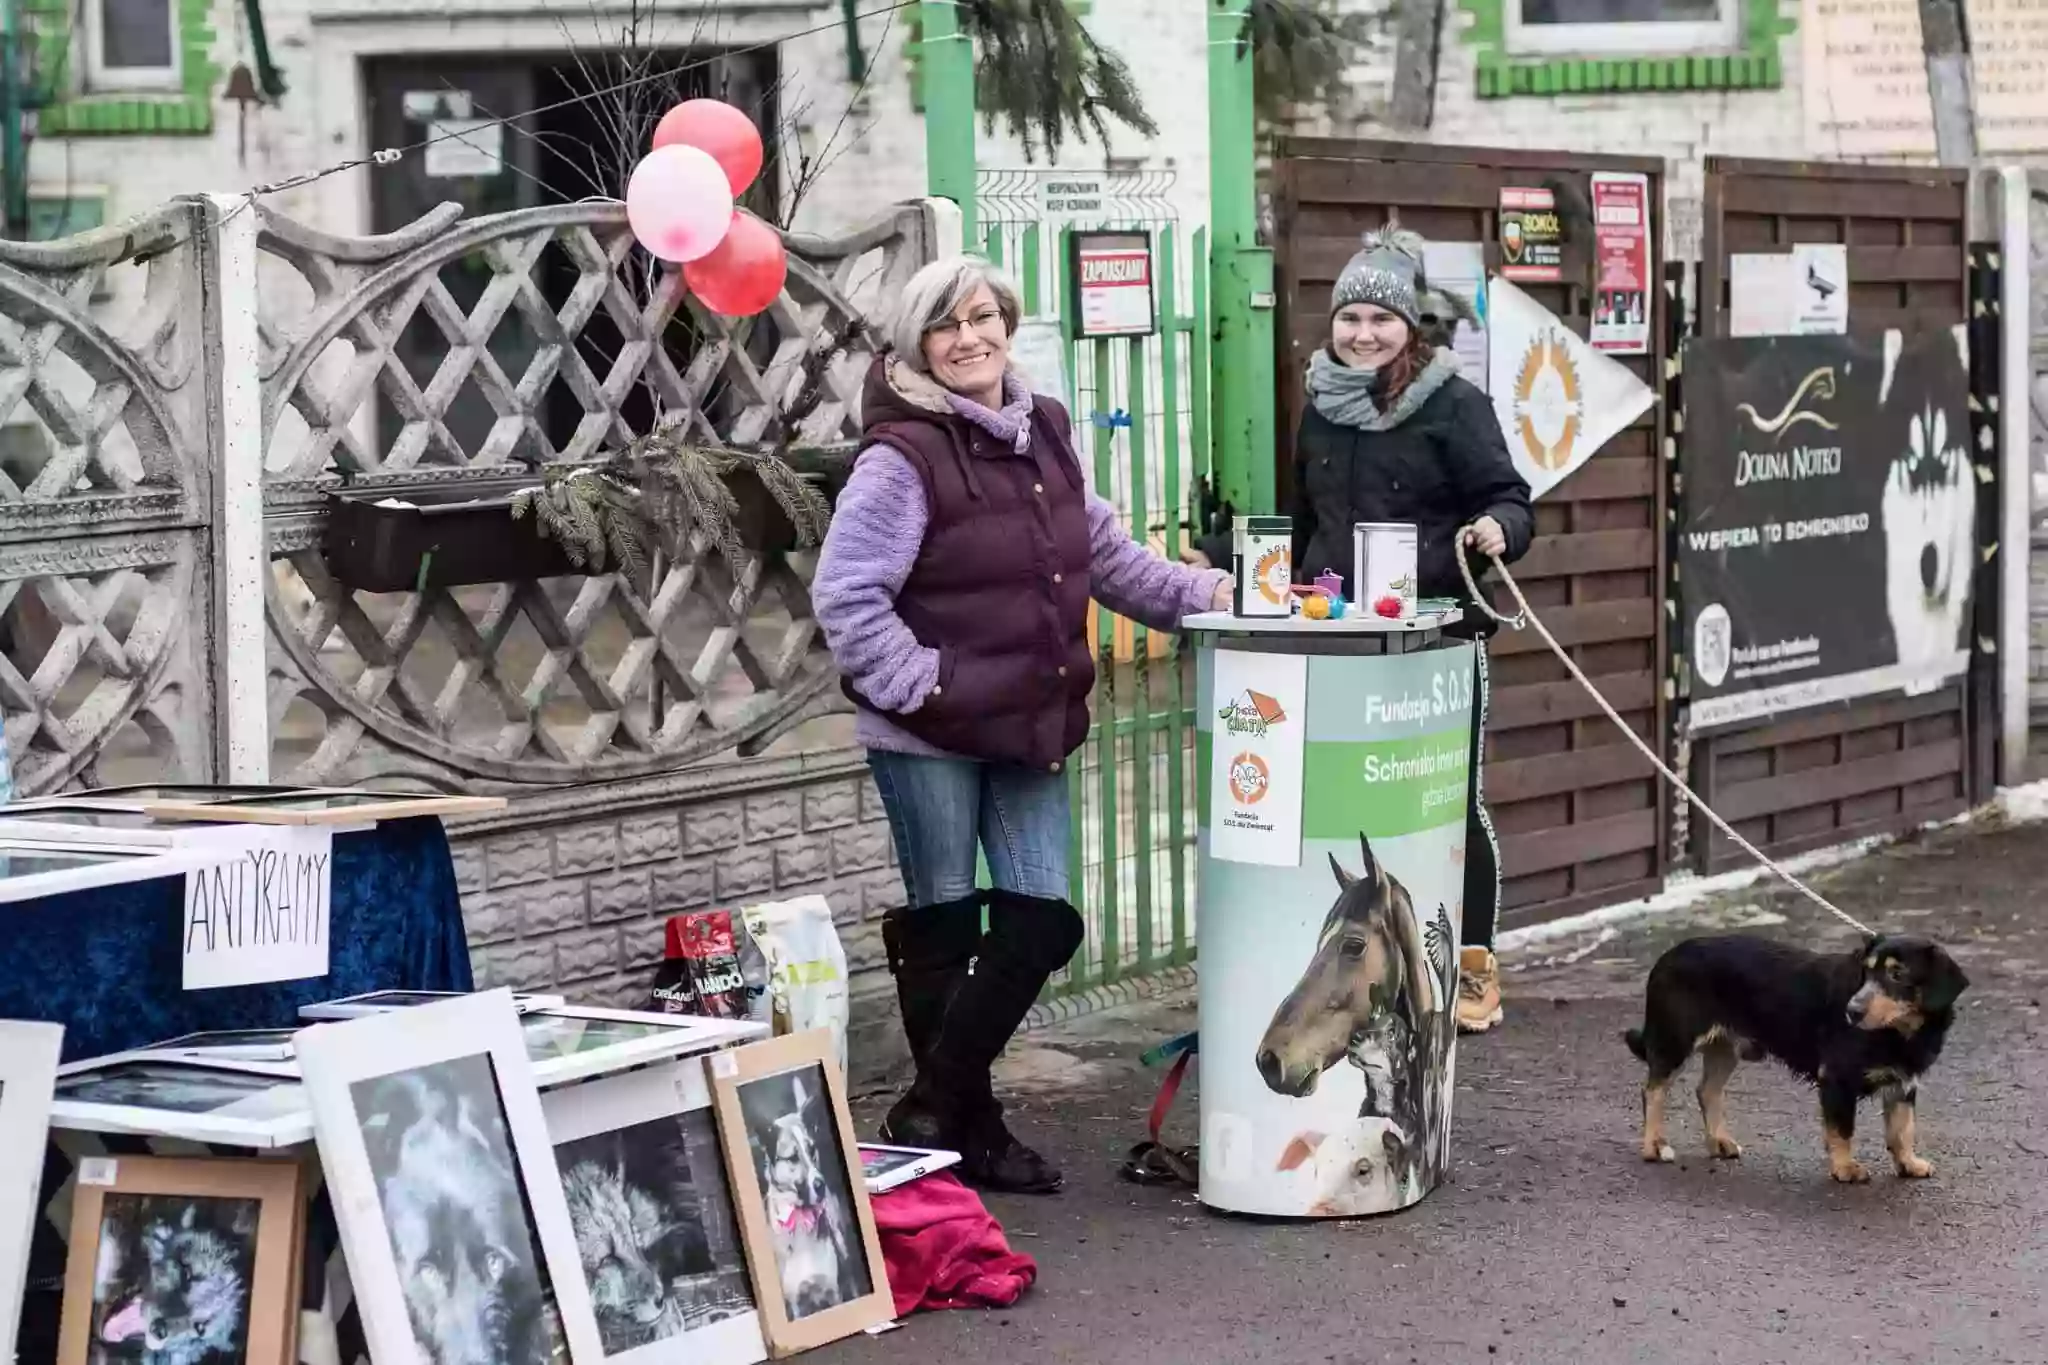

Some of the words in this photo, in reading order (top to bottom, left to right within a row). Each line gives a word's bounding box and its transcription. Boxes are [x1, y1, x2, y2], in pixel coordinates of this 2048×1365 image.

[1689, 526, 1760, 551] WSPIERA
[1762, 523, 1783, 543] TO
[1785, 512, 1870, 541] SCHRONISKO
[1364, 690, 1430, 729] Fundacja
[1364, 747, 1435, 783] Schronisko
[186, 848, 328, 954] ANTYRAMY
